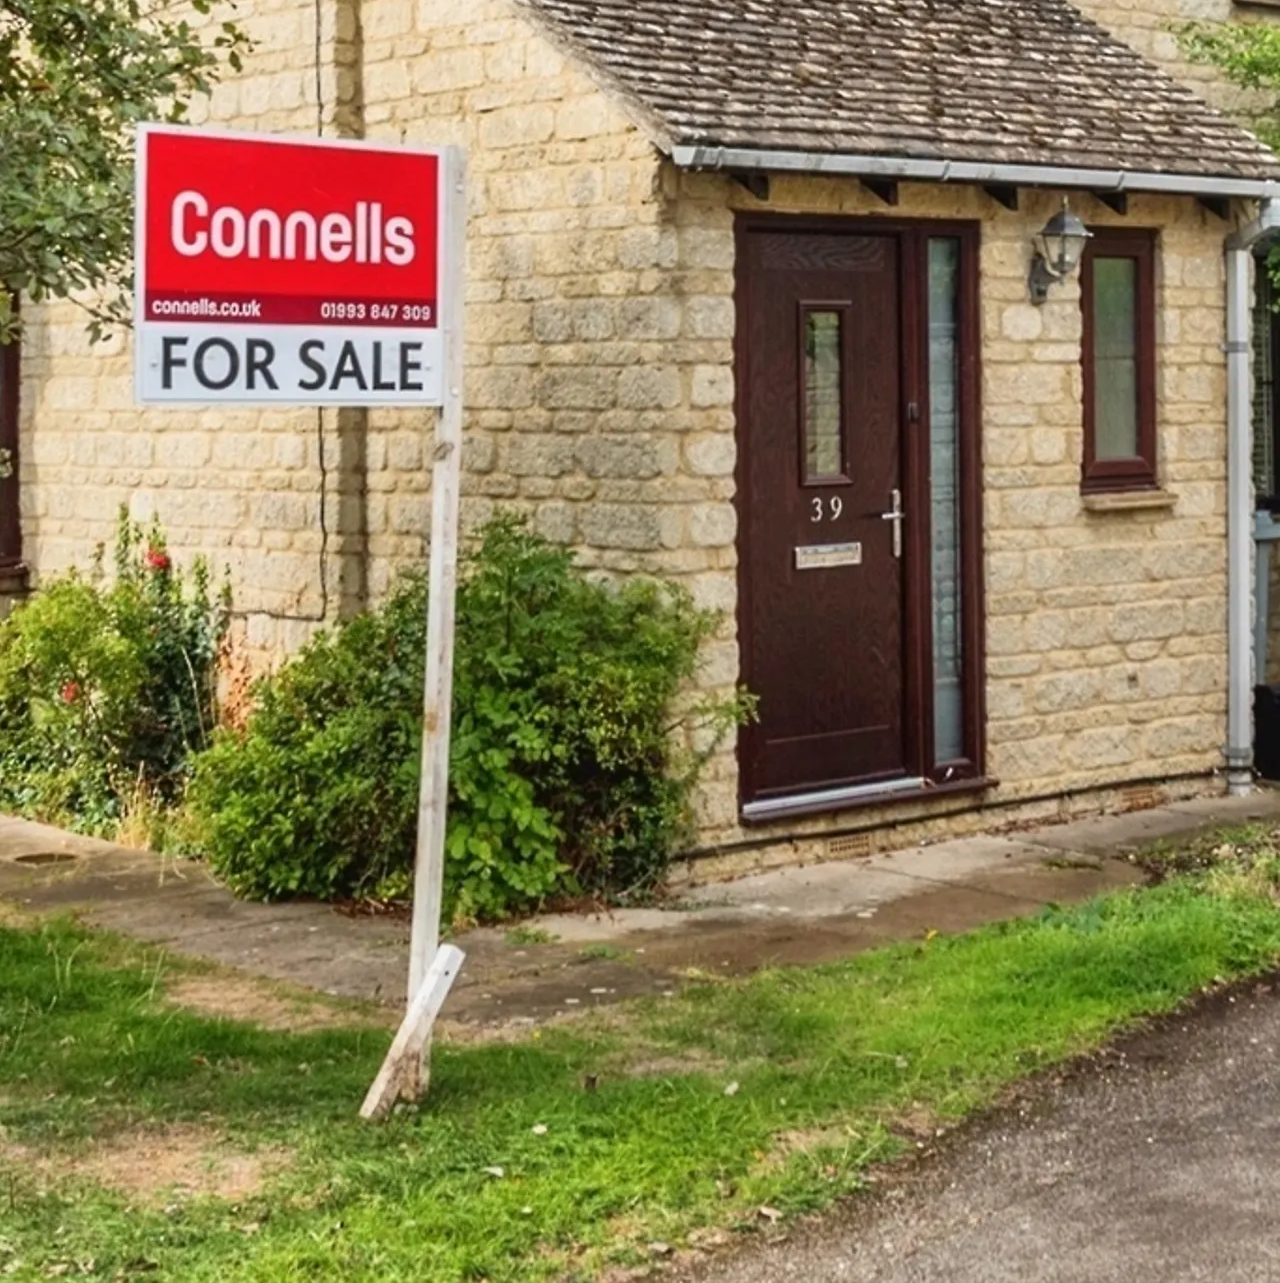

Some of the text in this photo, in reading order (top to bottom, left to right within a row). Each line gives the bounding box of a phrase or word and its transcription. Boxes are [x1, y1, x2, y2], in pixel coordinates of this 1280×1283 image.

[171, 190, 415, 266] Connells
[151, 298, 261, 317] connells.co.uk
[320, 302, 431, 320] 01993 847 309
[161, 336, 423, 391] FOR SALE
[810, 495, 843, 522] 39
